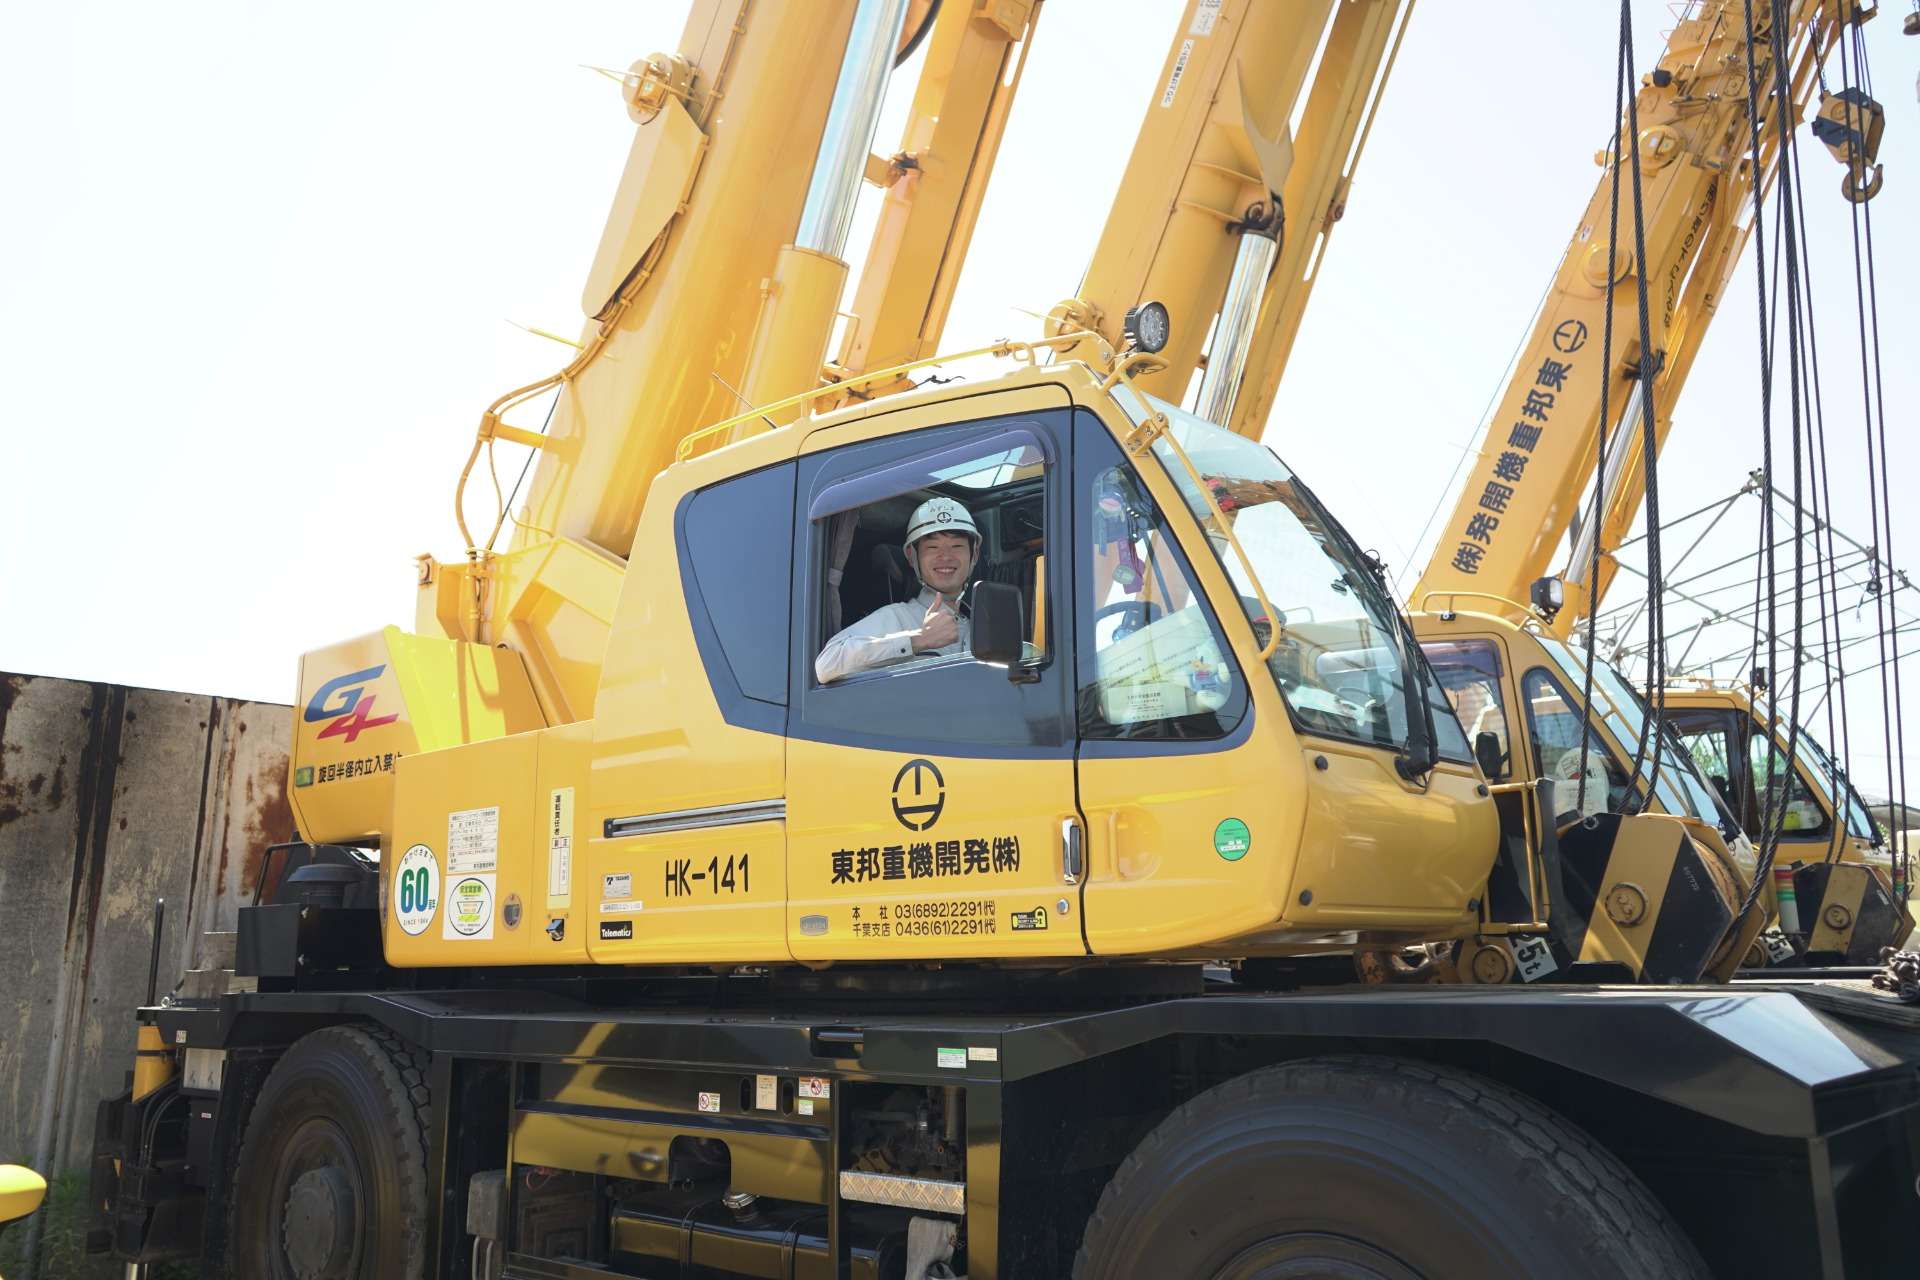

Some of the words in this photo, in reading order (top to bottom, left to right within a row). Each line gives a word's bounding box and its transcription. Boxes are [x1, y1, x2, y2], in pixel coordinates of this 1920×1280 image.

[665, 853, 749, 896] HK-141
[831, 836, 1020, 884] 東邦重機開発(株)
[401, 867, 429, 914] 60
[601, 927, 632, 938] Telematics
[852, 923, 890, 937] 千葉支店
[1512, 941, 1547, 975] 5t
